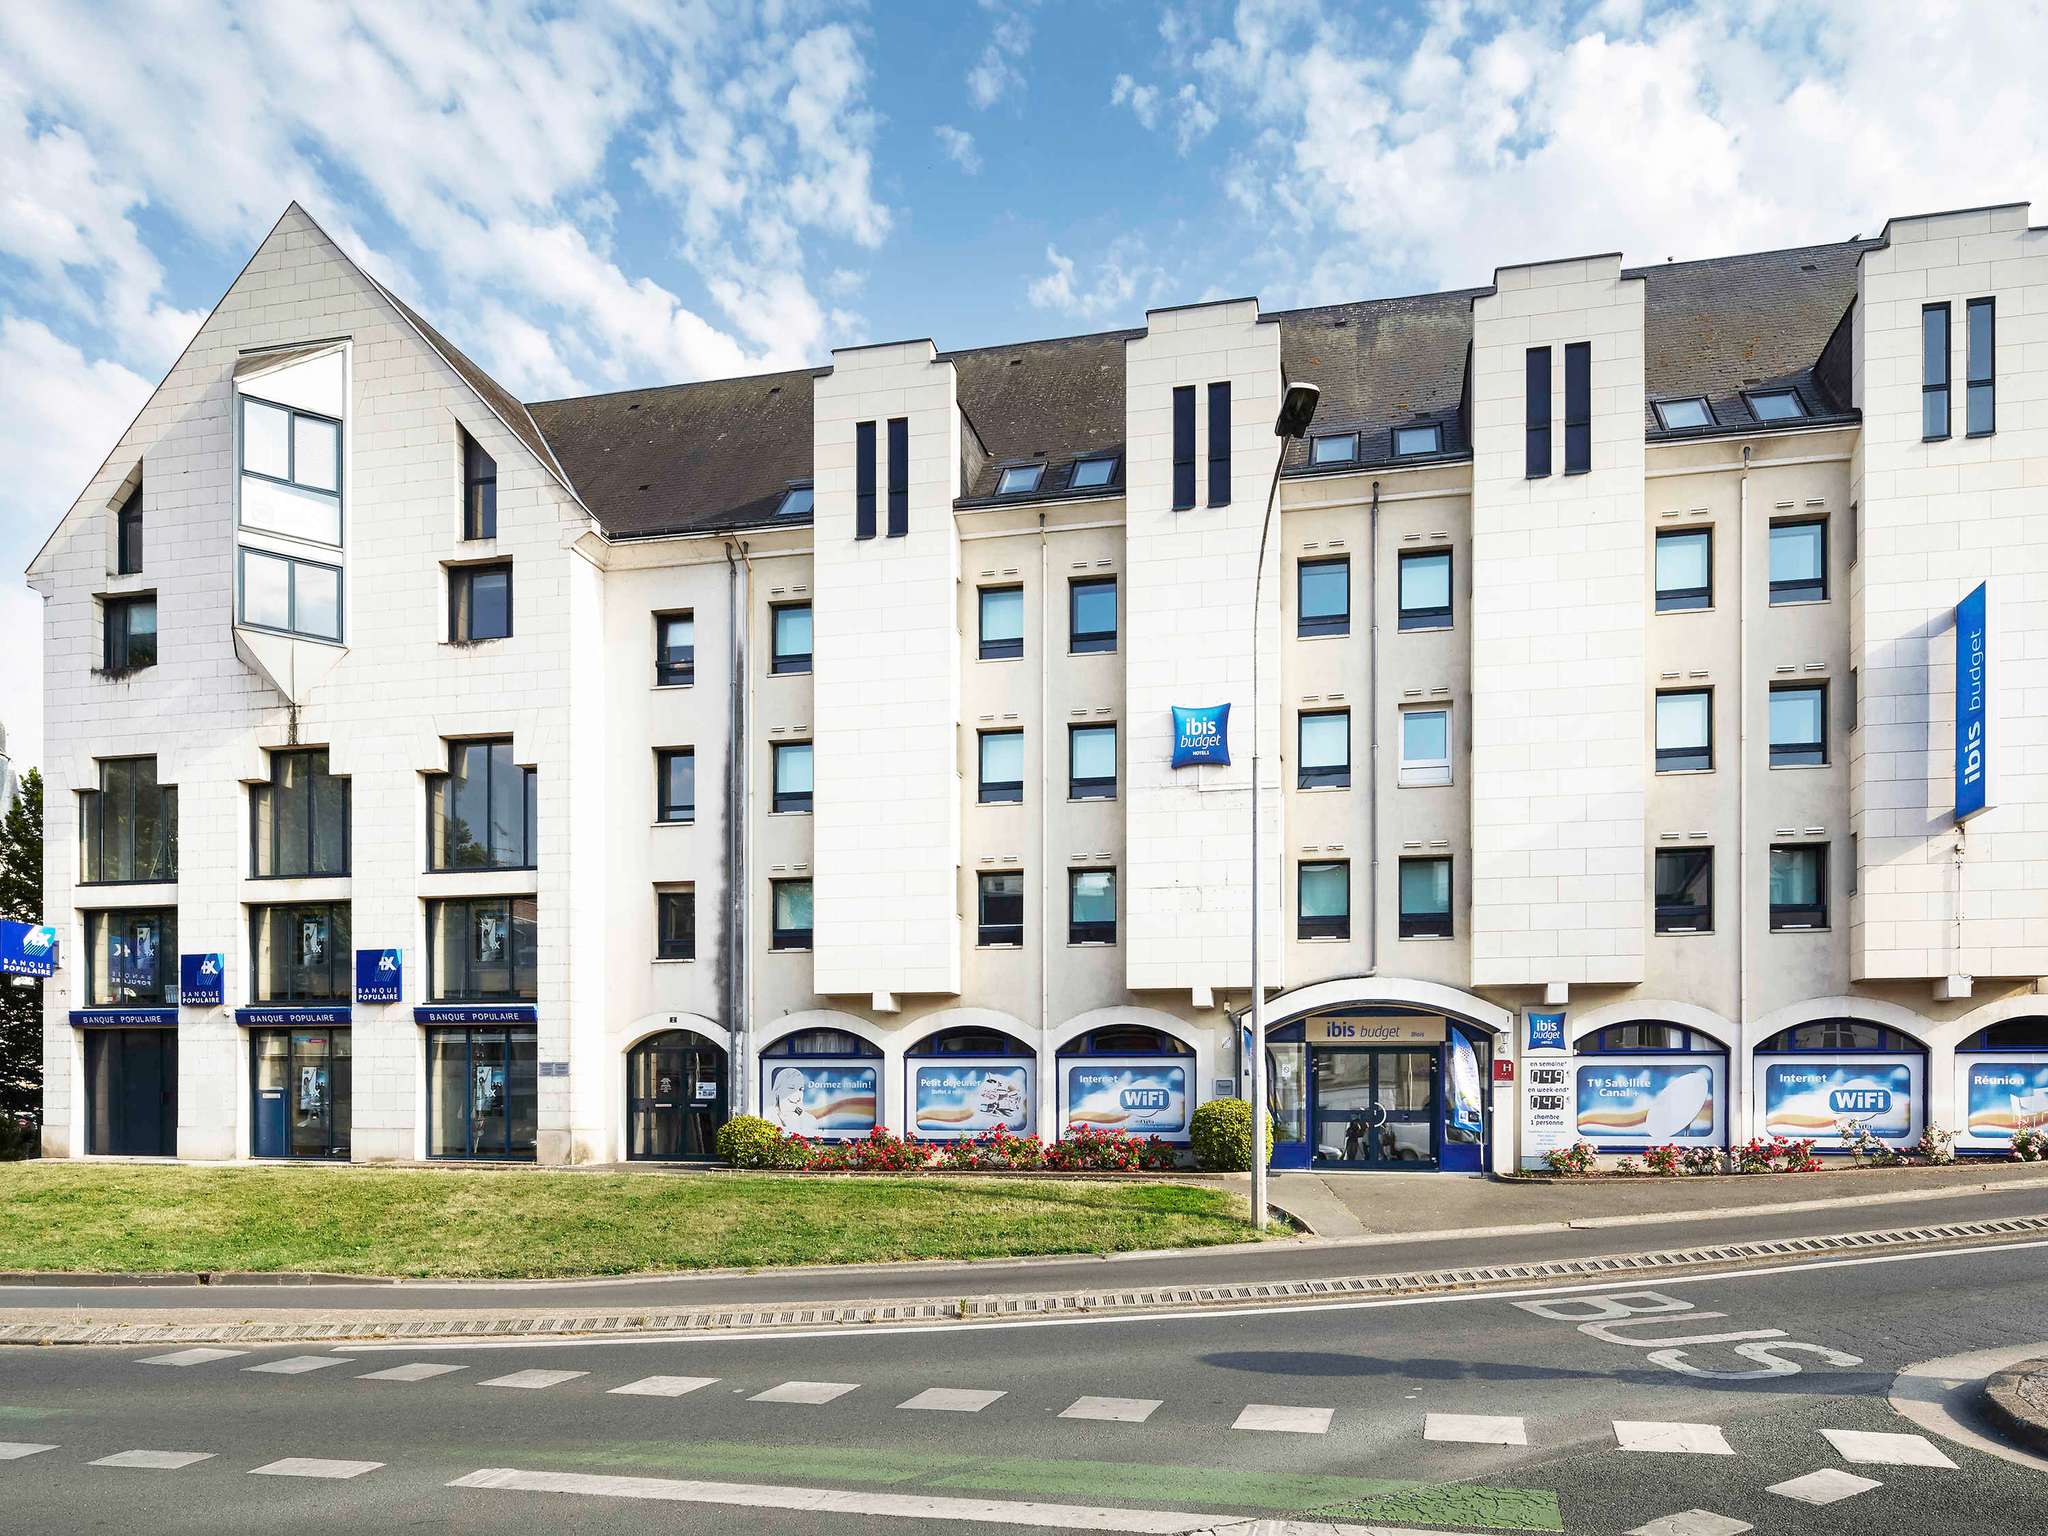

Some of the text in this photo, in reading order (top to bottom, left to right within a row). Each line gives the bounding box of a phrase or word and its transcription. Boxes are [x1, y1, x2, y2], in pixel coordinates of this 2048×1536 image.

[1964, 628, 1984, 785] ibis budget
[1185, 716, 1217, 736] ibis
[1180, 734, 1222, 750] budget
[3, 958, 51, 970] BANQUE
[3, 964, 51, 977] POPULAIRE
[82, 1015, 162, 1024] BANQUE POPULAIRE
[250, 1014, 335, 1023] BANQUE POPULAIRE
[429, 1013, 465, 1021] BANQUE
[1327, 1021, 1356, 1037] ibis
[1360, 1025, 1401, 1041] budget
[1536, 1020, 1558, 1032] ibis
[1532, 1031, 1561, 1041] budget
[1502, 1063, 1512, 1072] H
[920, 1079, 941, 1087] Petit
[1079, 1075, 1119, 1084] Internet
[1586, 1079, 1651, 1088] TV Satellite
[1780, 1073, 1827, 1083] Internet
[1974, 1073, 2025, 1085] Réunion
[808, 1080, 841, 1089] Dormez
[1599, 1088, 1629, 1097] Canal
[1125, 1091, 1164, 1106] WiFi
[1835, 1091, 1885, 1109] WiFi
[1509, 1290, 1864, 1380] BUS
